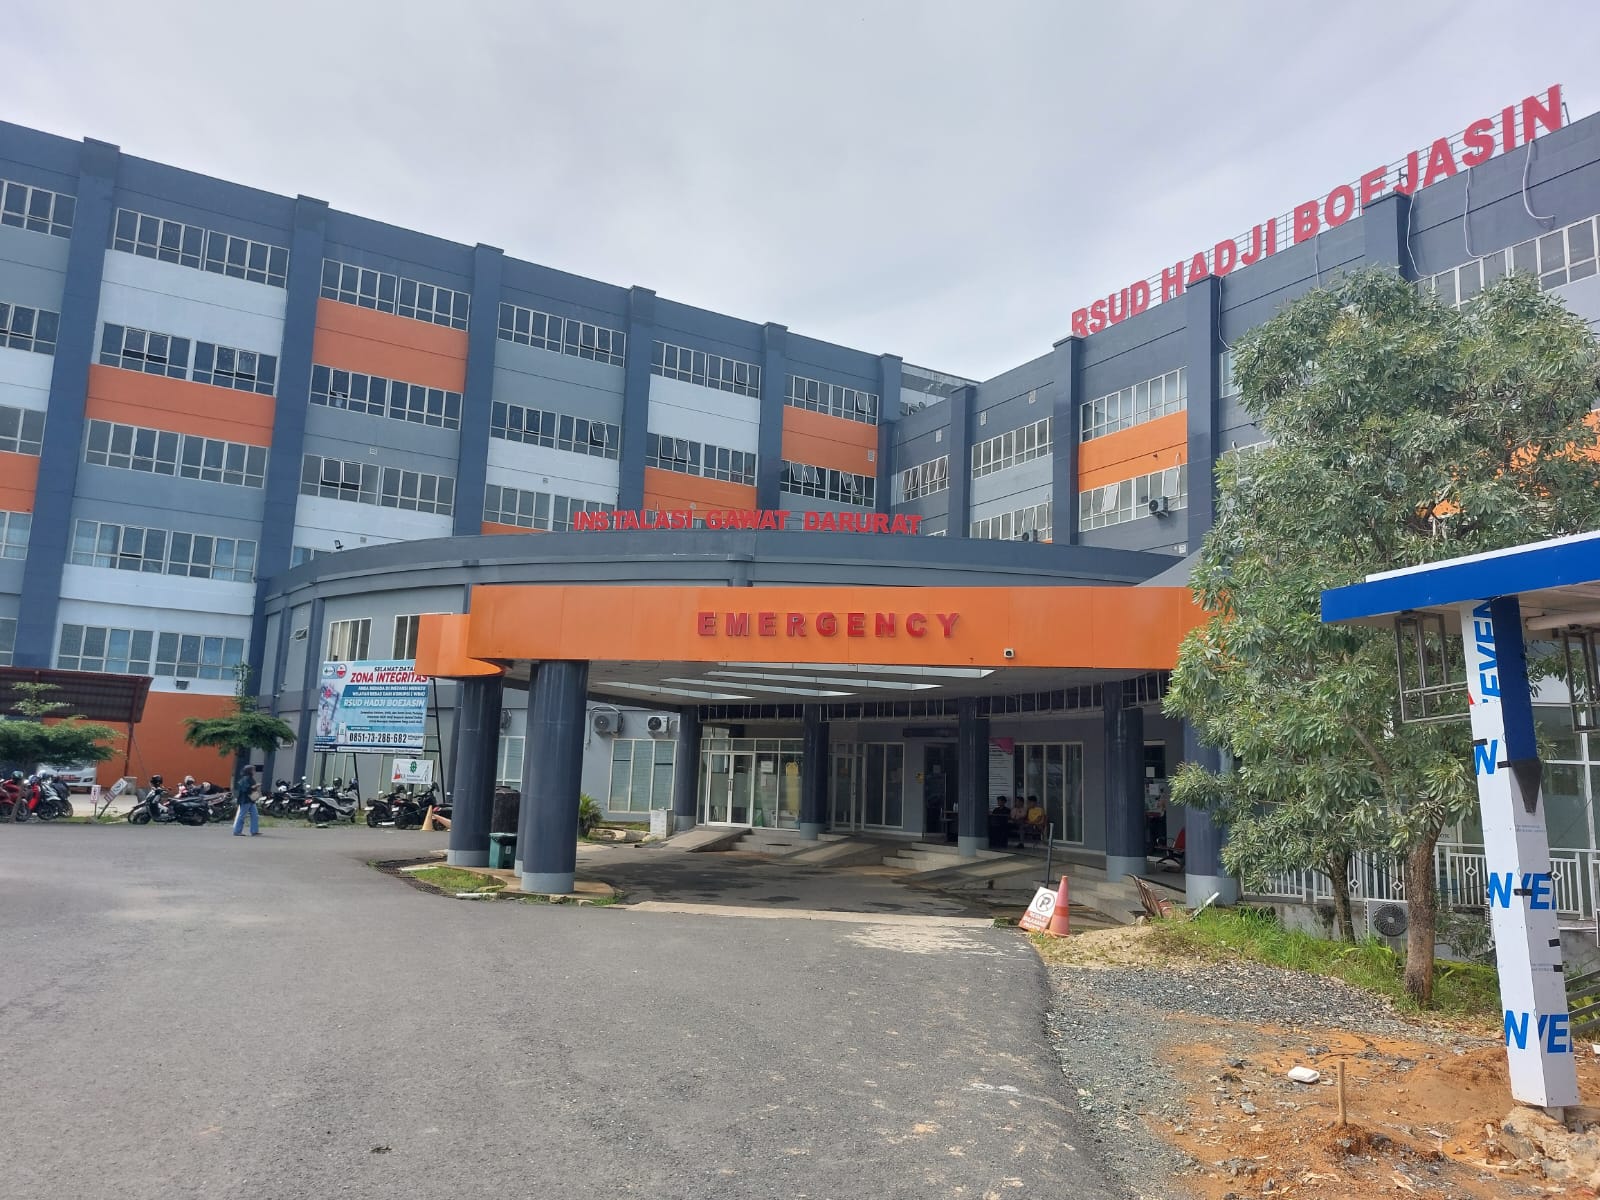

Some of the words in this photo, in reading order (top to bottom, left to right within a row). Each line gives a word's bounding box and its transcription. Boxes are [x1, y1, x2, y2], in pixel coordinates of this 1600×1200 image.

[1071, 279, 1150, 337] RSUD
[1162, 217, 1277, 304] HADJI
[573, 509, 694, 531] INSTALASI
[705, 509, 790, 531] GAWAT
[803, 511, 923, 534] DARURAT
[697, 611, 960, 638] EMERGENCY
[350, 672, 374, 683] ZONA
[343, 699, 362, 707] RSUD
[364, 699, 385, 707] HADJI
[349, 732, 407, 744] 0851-73-286-682
